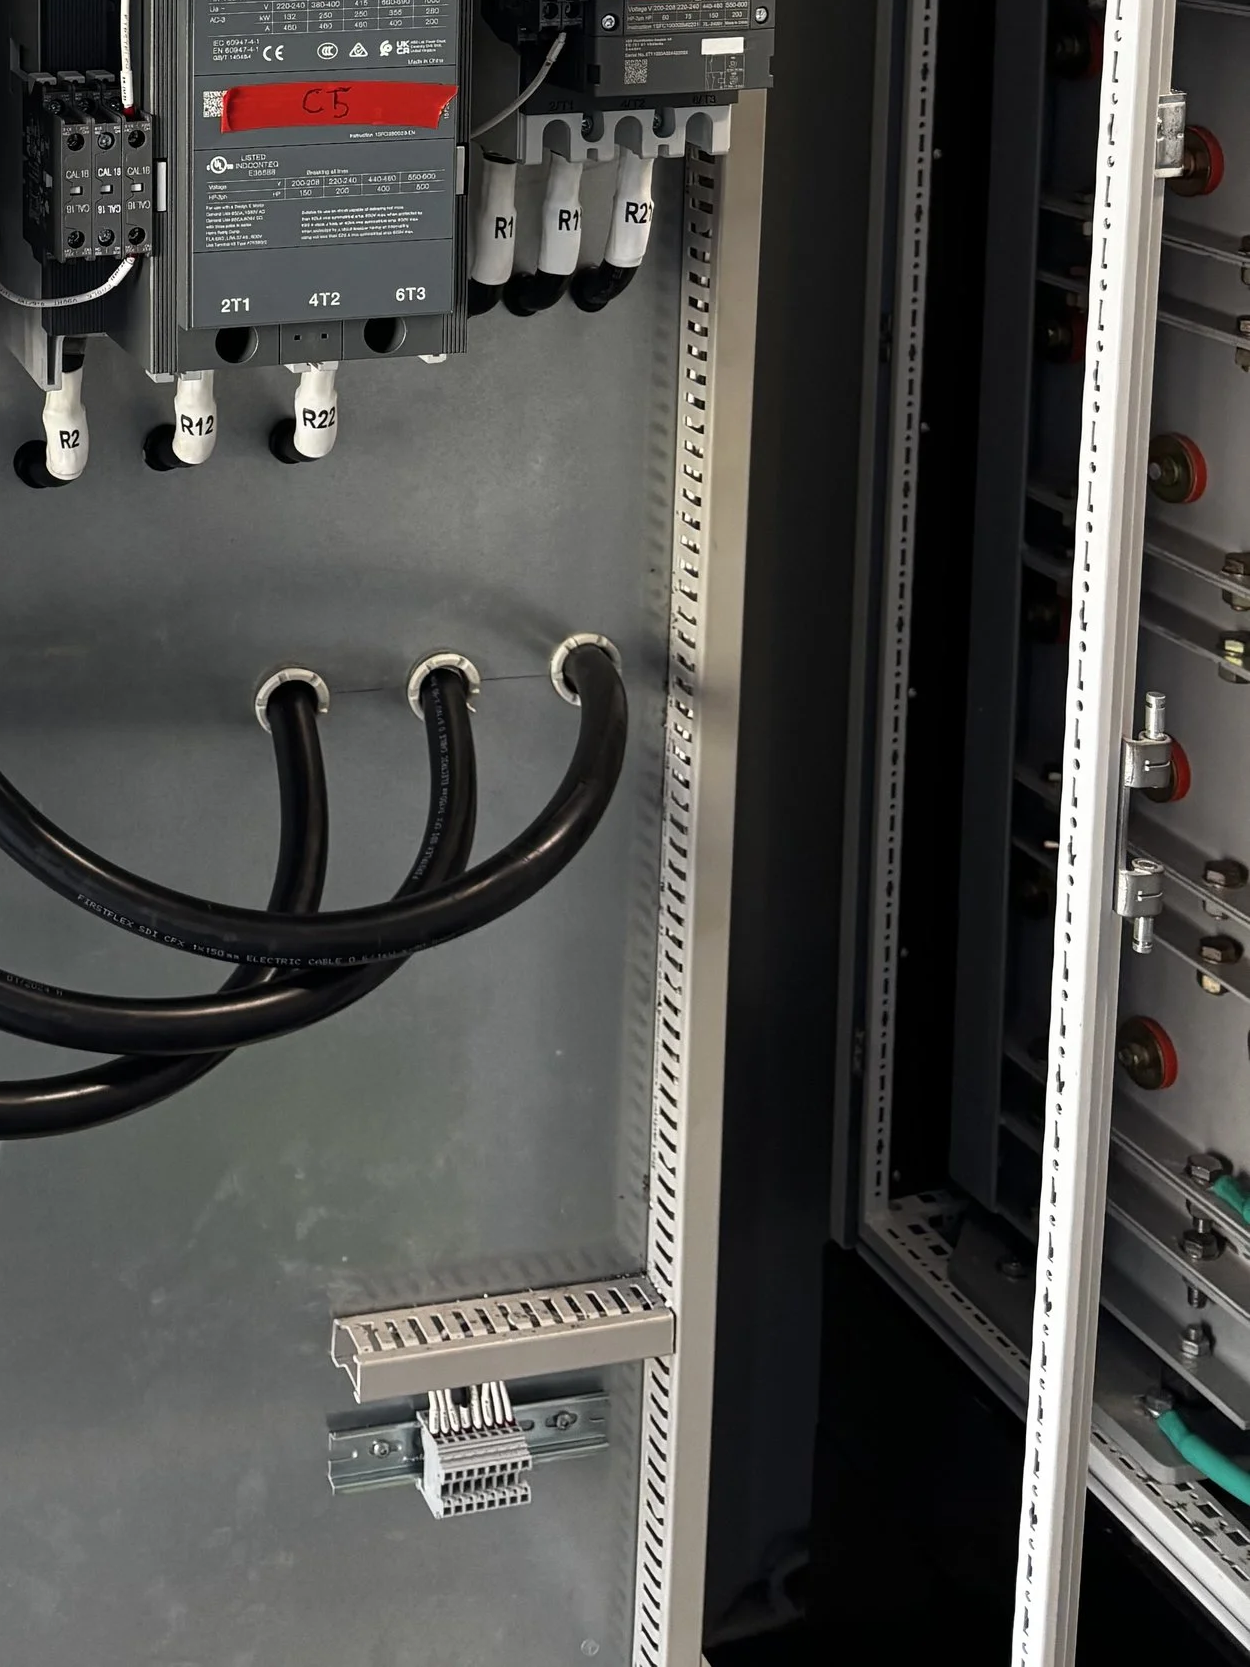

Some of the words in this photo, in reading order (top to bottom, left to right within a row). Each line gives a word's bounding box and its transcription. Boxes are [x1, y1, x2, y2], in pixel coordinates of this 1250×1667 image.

[310, 0, 340, 8] 380-400
[627, 5, 648, 13] Voltage
[302, 86, 353, 119] C5
[240, 154, 267, 162] LISTED
[65, 169, 80, 179] CAL
[97, 168, 111, 177] CAL
[126, 166, 141, 176] CAL
[76, 203, 90, 213] CAL
[108, 204, 121, 214] CAL
[138, 200, 150, 210] CAL
[220, 297, 251, 313] 2T1
[308, 292, 341, 307] 4T2
[395, 287, 426, 302] 6T3
[302, 406, 336, 429] R22
[180, 413, 214, 436] R12
[59, 428, 80, 449] R2
[76, 893, 135, 928] FIRSTFLEX
[138, 925, 159, 938] SDI
[246, 955, 302, 966] ELECTRIC
[308, 957, 343, 966] CABLE
